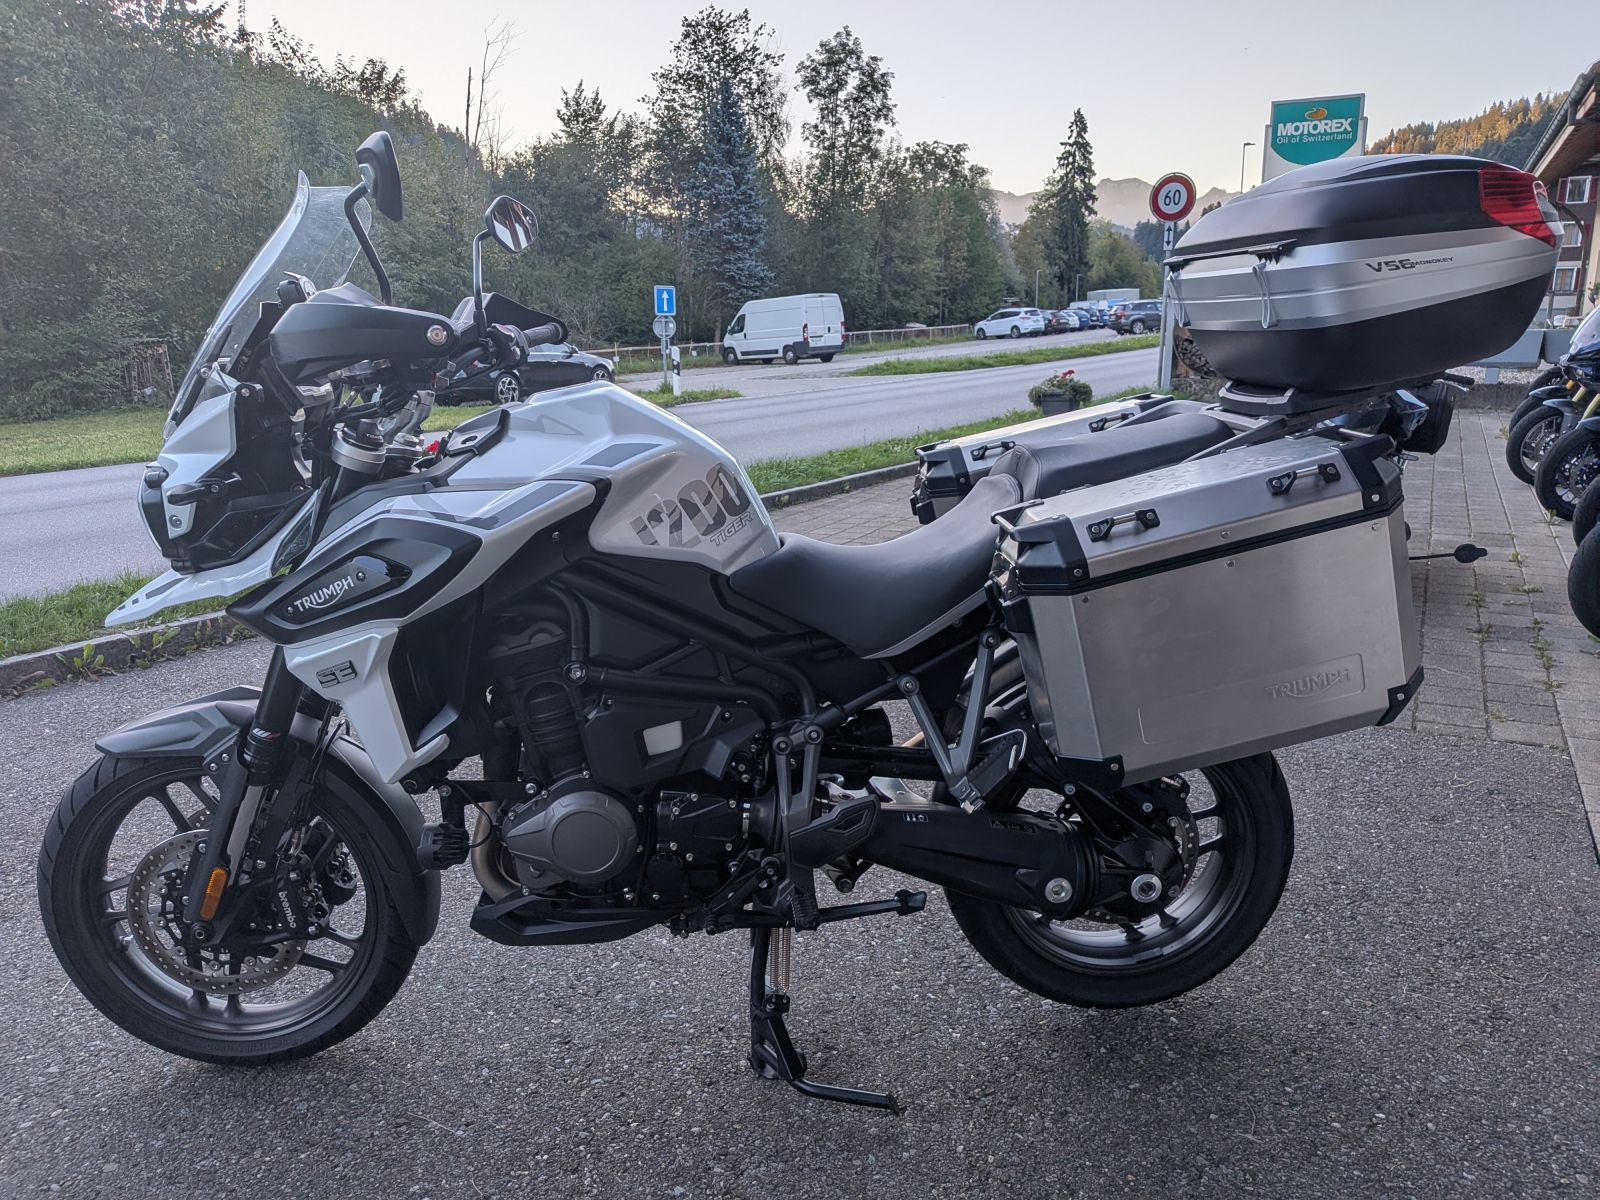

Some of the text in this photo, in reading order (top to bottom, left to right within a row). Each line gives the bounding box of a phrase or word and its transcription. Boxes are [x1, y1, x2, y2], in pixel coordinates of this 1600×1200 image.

[1276, 132, 1353, 144] Oil of Switzerland
[1277, 118, 1353, 136] MOTOREX
[1163, 189, 1182, 207] 60
[1364, 258, 1416, 273] V56
[629, 462, 751, 548] 1200
[709, 511, 754, 546] TIGER
[293, 575, 355, 612] TRIUMPH
[1264, 668, 1350, 700] TRIUMPH
[278, 890, 297, 929] brembo
